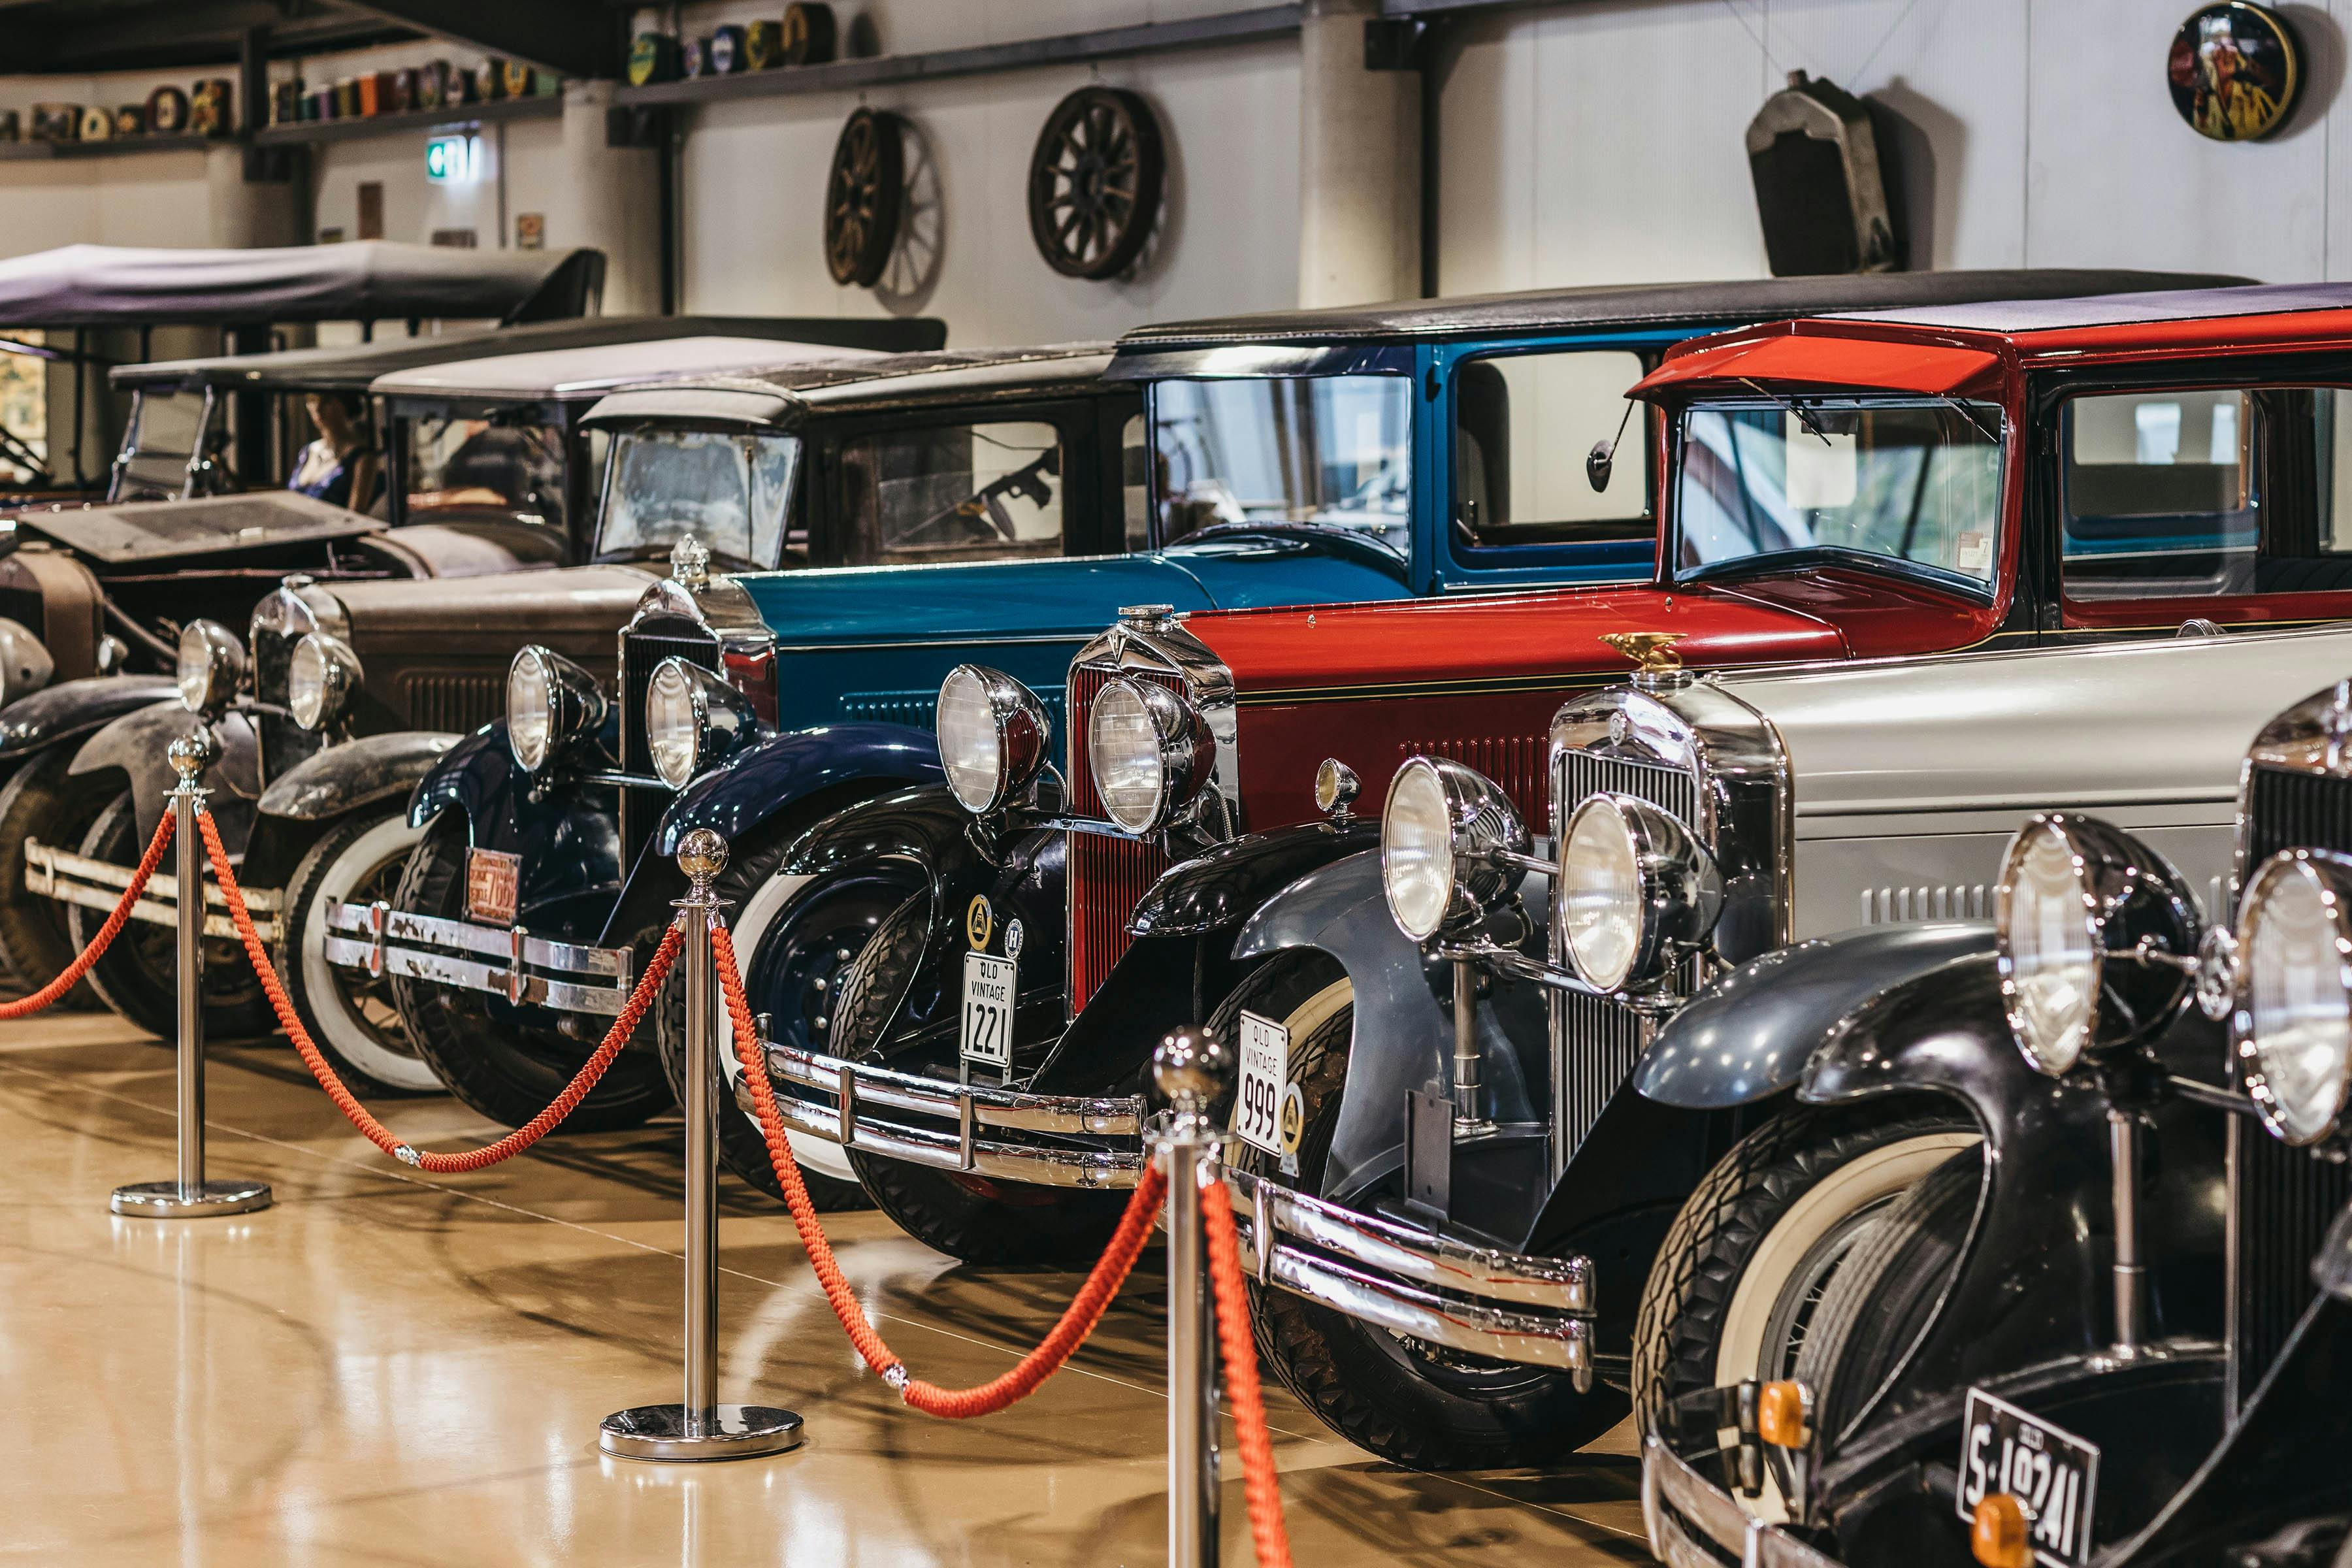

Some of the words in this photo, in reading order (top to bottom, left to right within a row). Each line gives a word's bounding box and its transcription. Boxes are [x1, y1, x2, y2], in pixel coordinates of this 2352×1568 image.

[1009, 930, 1019, 947] H
[981, 960, 998, 979] QLD
[972, 980, 1005, 1002] VINTAGE
[966, 1002, 1006, 1056] 1221
[1253, 1025, 1269, 1047] QLD
[1246, 1046, 1277, 1077] VINTAGE
[1245, 1072, 1275, 1141] 999
